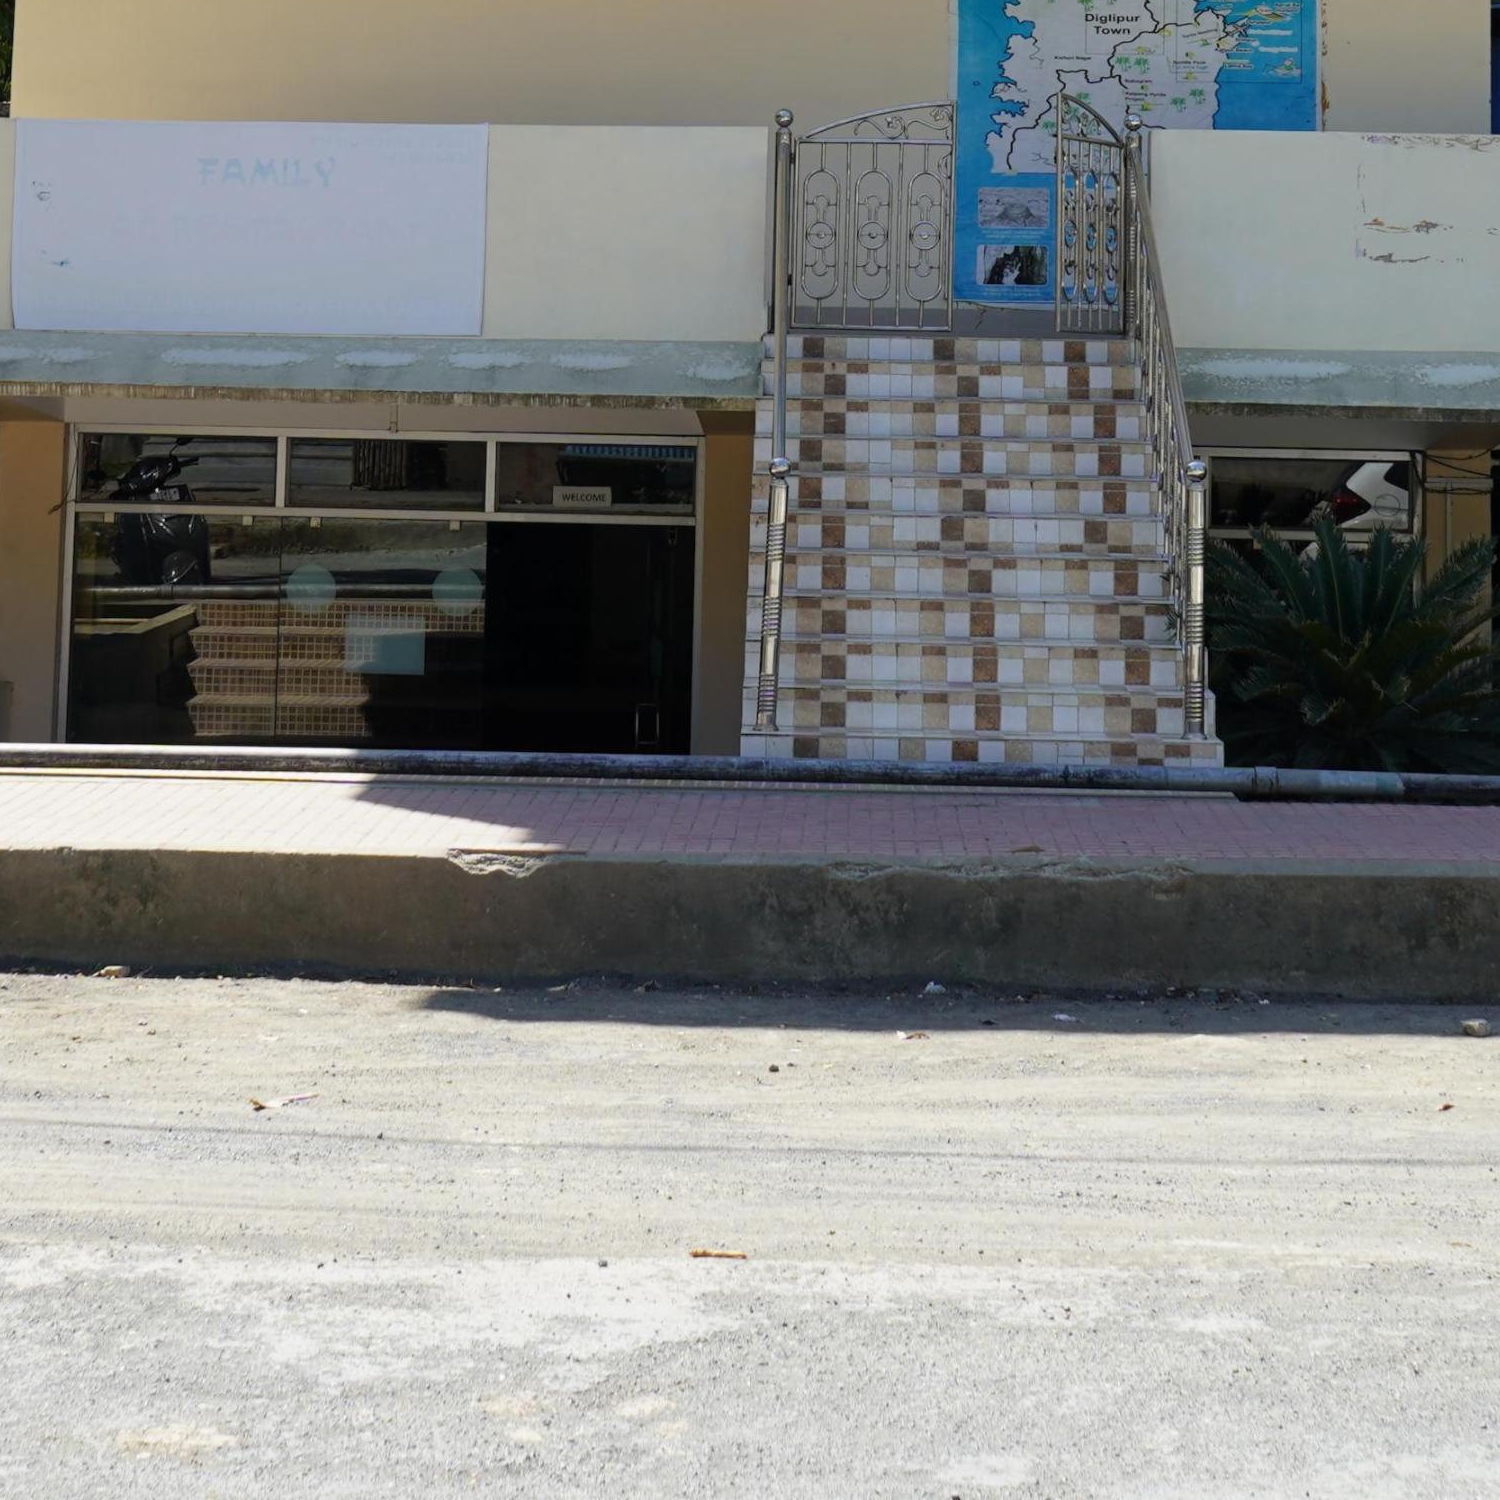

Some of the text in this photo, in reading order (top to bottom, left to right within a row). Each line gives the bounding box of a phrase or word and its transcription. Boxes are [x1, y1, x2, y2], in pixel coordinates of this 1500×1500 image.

[1085, 13, 1140, 24] Diglipur
[1094, 26, 1131, 35] Town
[197, 157, 337, 188] FAMILY
[562, 493, 606, 502] WELCOME
